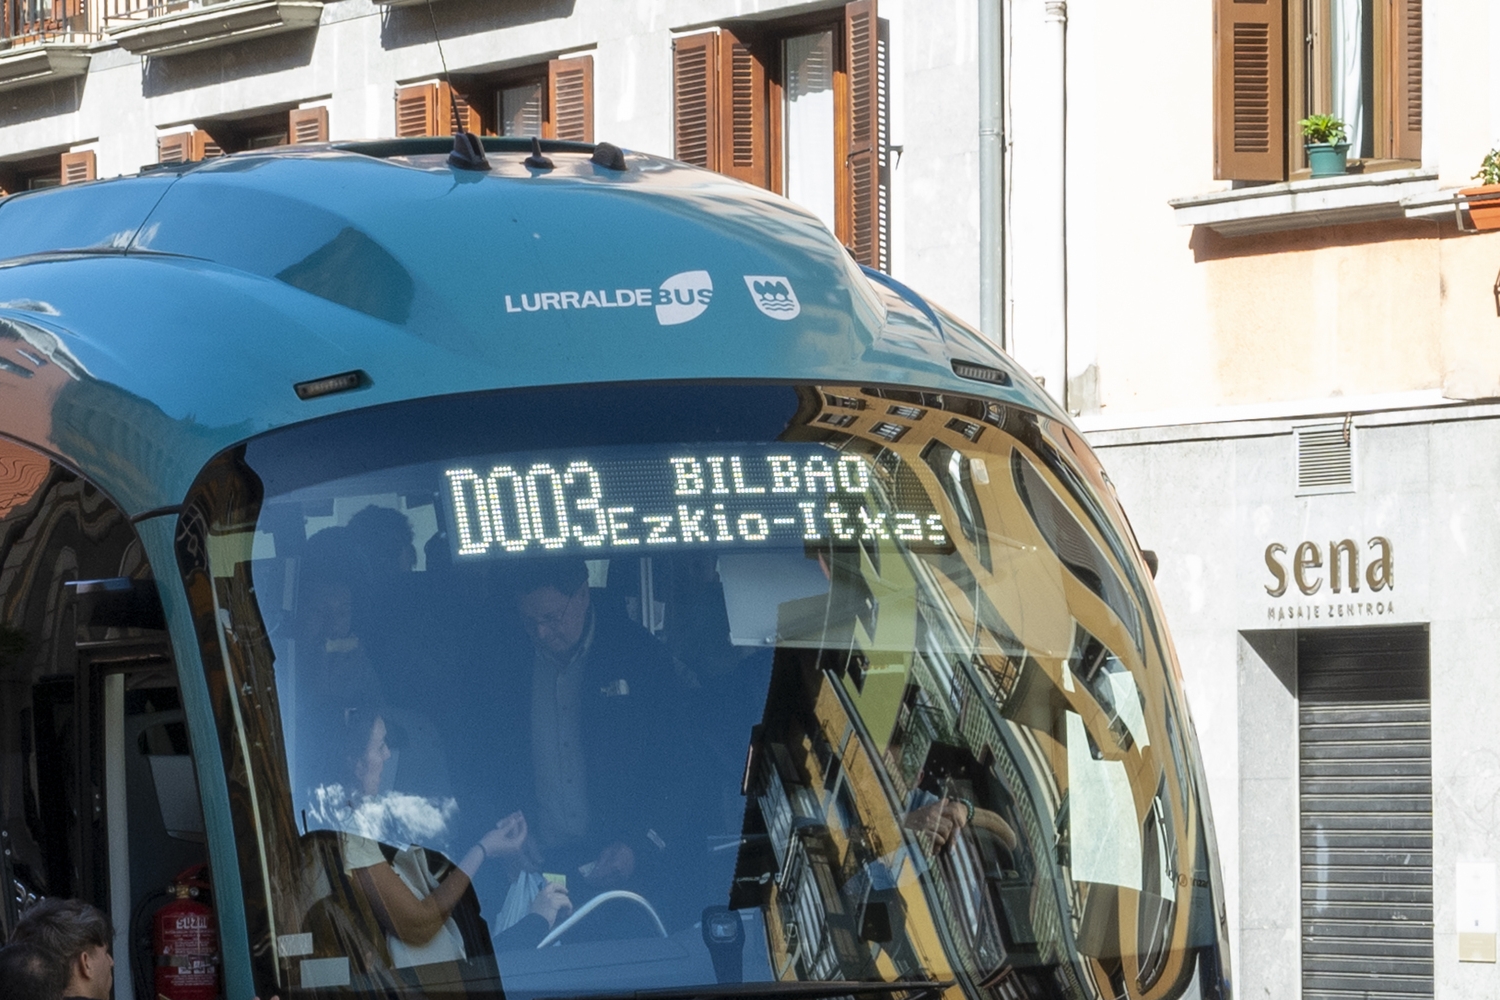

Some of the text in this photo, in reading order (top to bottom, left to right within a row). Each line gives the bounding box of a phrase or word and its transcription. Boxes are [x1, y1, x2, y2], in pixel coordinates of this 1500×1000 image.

[670, 455, 871, 496] BILBAO
[1264, 536, 1394, 598] sena
[1267, 601, 1395, 621] MASAJE ZENTROA
